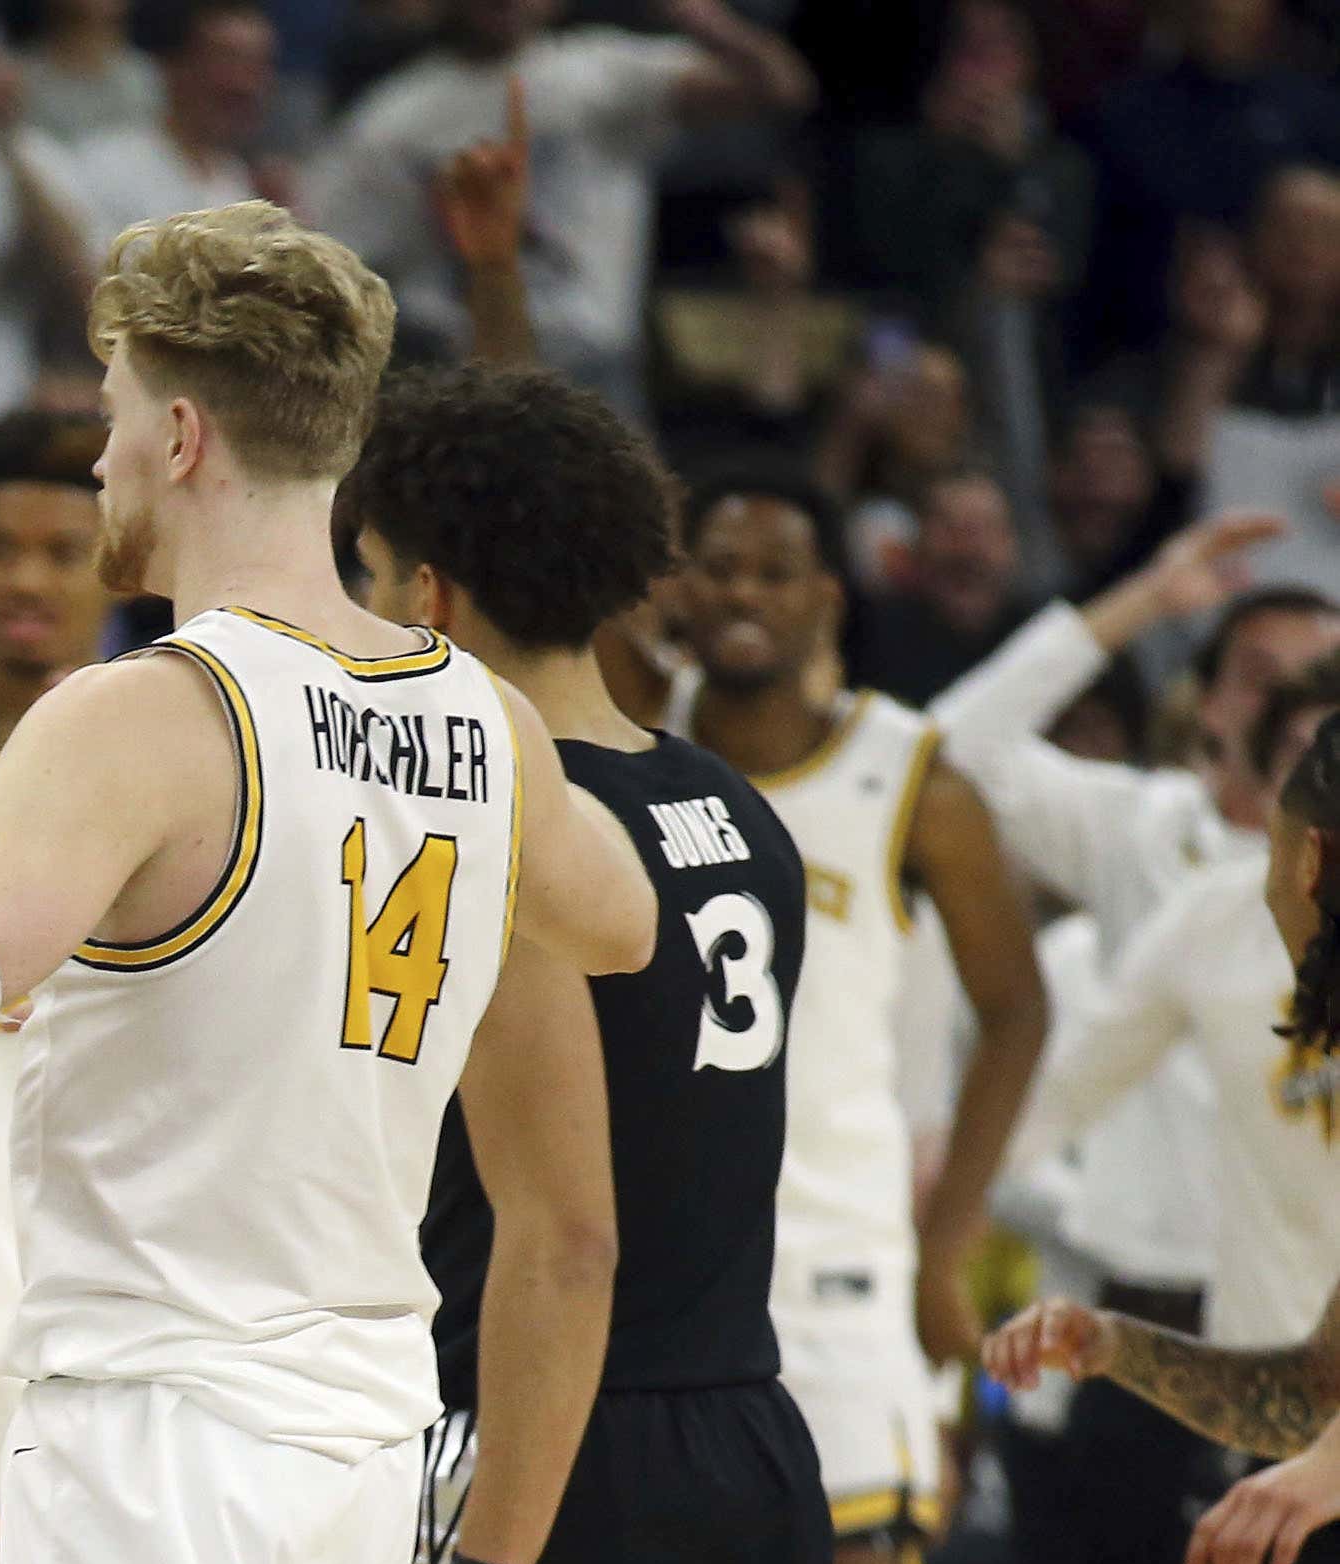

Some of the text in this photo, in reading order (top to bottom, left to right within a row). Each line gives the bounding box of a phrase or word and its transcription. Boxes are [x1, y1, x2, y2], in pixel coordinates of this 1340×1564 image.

[646, 795, 752, 869] JONES
[340, 816, 459, 1065] 14
[682, 892, 785, 1072] 3
